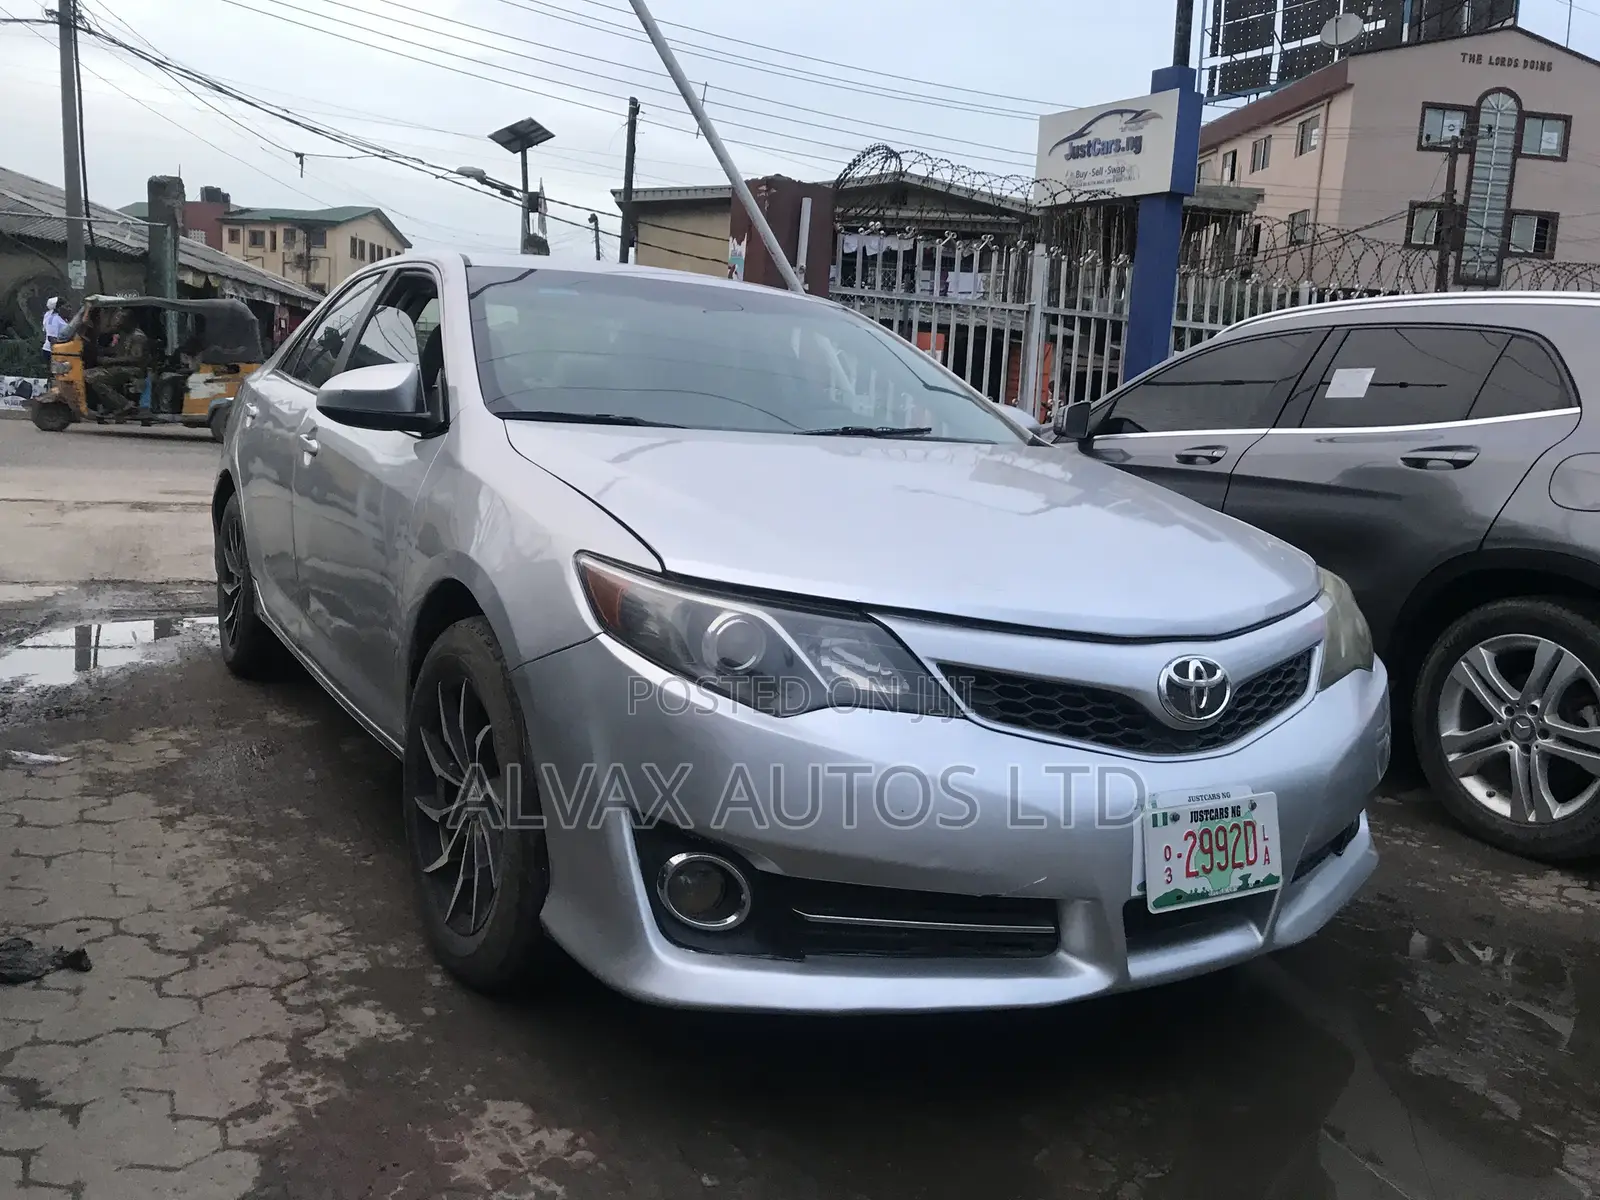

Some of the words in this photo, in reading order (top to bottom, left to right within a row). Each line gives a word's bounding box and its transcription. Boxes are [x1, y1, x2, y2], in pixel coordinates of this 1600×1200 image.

[1461, 52, 1482, 64] THE
[1488, 55, 1519, 68] LORDS
[1523, 59, 1553, 72] DOING
[1064, 135, 1143, 161] JustCars.ng
[1187, 793, 1221, 803] JUSTCARS
[1221, 791, 1231, 799] NG
[1190, 807, 1229, 823] JUSTCARS
[1231, 805, 1241, 818] NG
